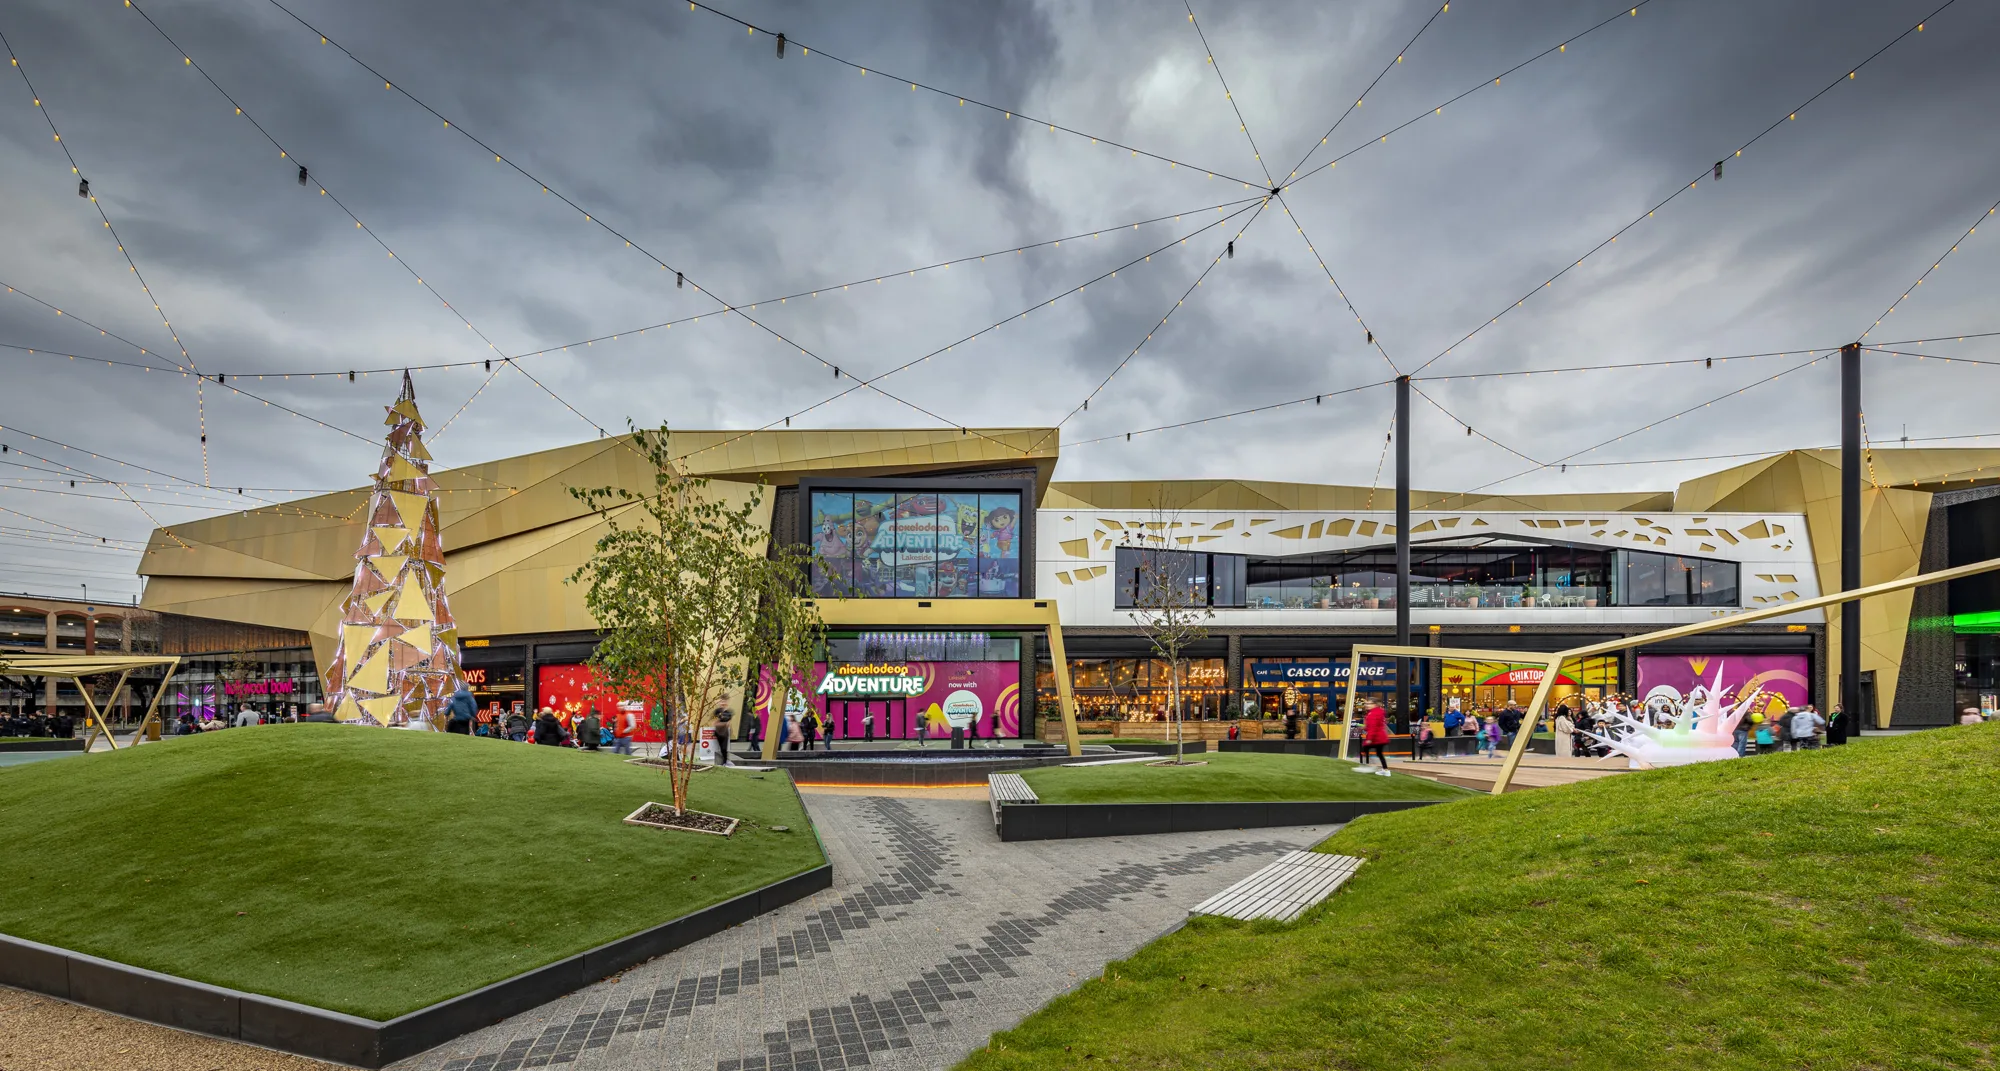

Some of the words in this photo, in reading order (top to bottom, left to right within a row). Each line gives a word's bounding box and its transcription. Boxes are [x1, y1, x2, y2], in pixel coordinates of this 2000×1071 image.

[872, 529, 963, 551] ADVENTURE
[901, 553, 933, 561] Lakeside
[839, 663, 909, 675] nickelodeon
[1188, 666, 1226, 678] Zizzi
[1286, 667, 1331, 678] CASCO
[1333, 666, 1385, 677] LONGE
[270, 677, 293, 694] bowl
[816, 671, 924, 695] ADVENTURE
